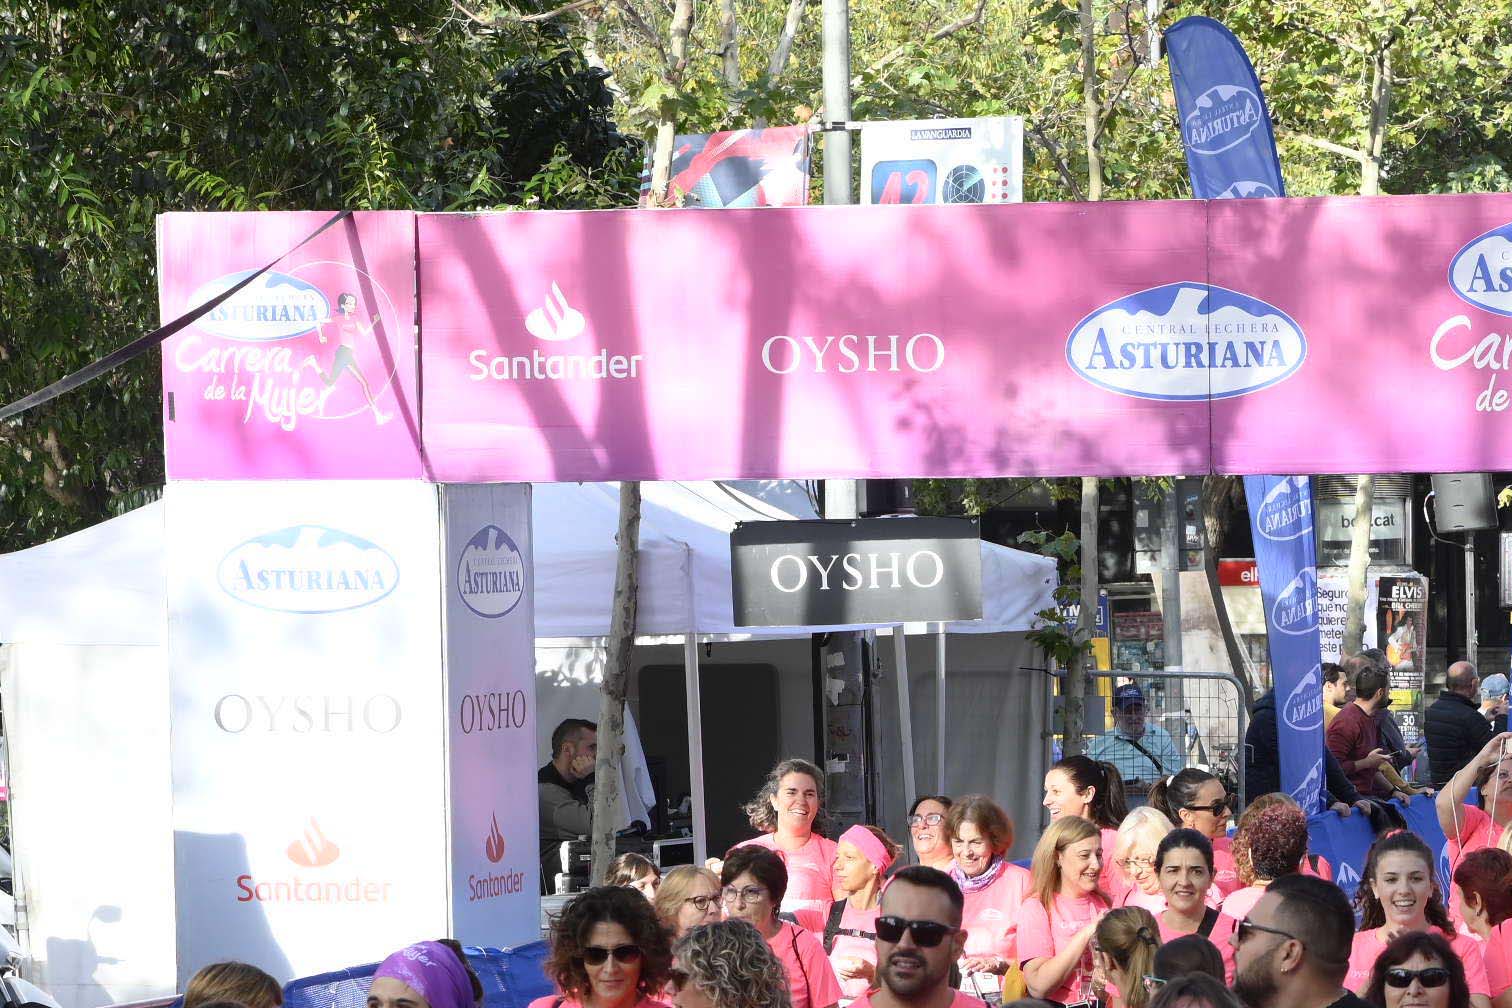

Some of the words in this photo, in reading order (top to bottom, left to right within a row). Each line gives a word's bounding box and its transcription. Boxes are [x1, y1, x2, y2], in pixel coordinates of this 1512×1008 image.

[1122, 323, 1196, 334] CENTRAL
[1205, 322, 1279, 333] LECHERA
[175, 335, 292, 374] Carrera
[470, 349, 643, 382] Santander
[761, 333, 945, 374] OYSHO
[1085, 327, 1287, 369] ASTURIANA
[204, 375, 225, 401] de
[231, 373, 247, 401] la
[244, 371, 336, 431] Mujer
[1476, 374, 1509, 412] de
[233, 558, 386, 592] ASTURIANA
[463, 561, 520, 595] ASTURIANA
[770, 550, 944, 593] OYSHO
[1392, 586, 1423, 598] ELVIS
[214, 694, 402, 734] OYSHO
[460, 689, 527, 735] OYSHO
[1402, 715, 1414, 726] 30
[237, 873, 391, 902] Santander
[469, 871, 524, 901] Santander
